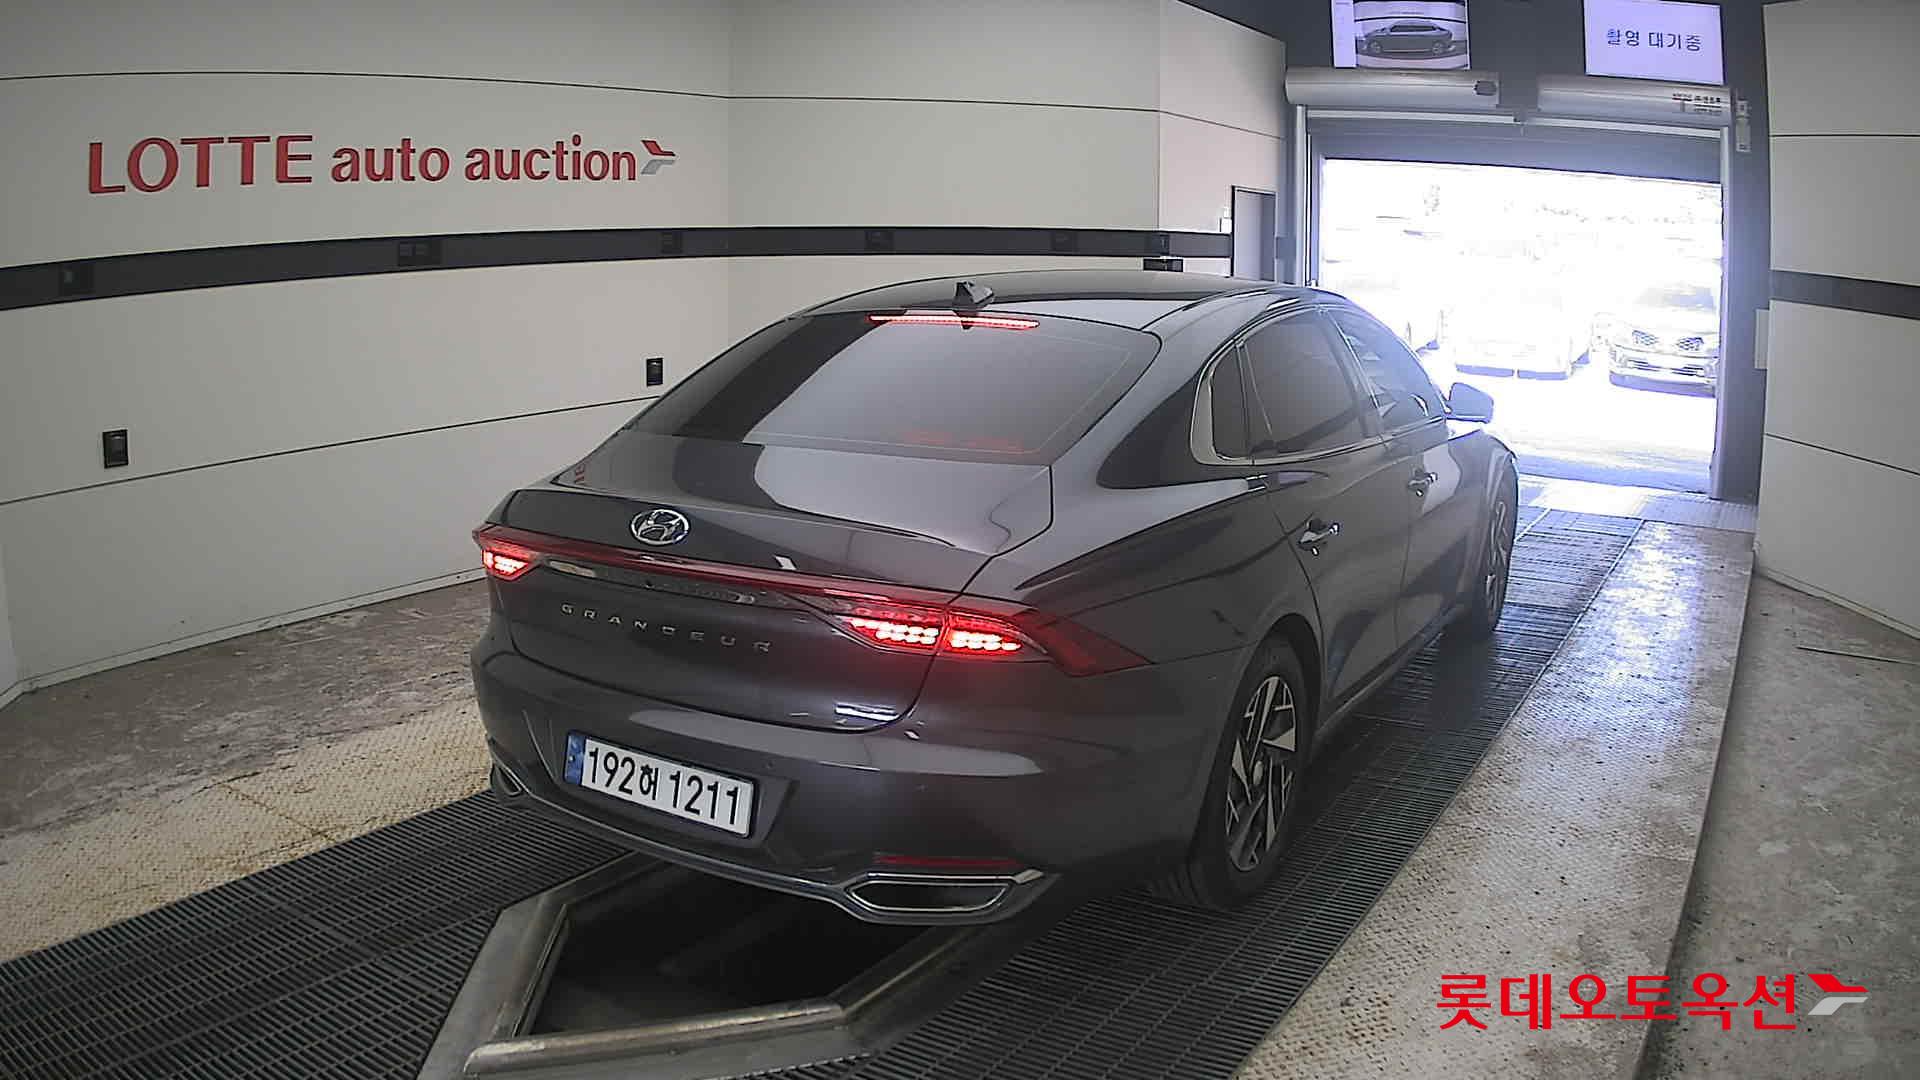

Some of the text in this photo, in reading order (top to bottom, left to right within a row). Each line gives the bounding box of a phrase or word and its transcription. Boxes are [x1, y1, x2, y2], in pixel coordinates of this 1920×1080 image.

[1648, 32, 1702, 52] 대기중
[88, 134, 637, 194] LOTTE auto auction
[561, 603, 771, 652] GRANDEUR
[588, 747, 741, 826] 192허 1211
